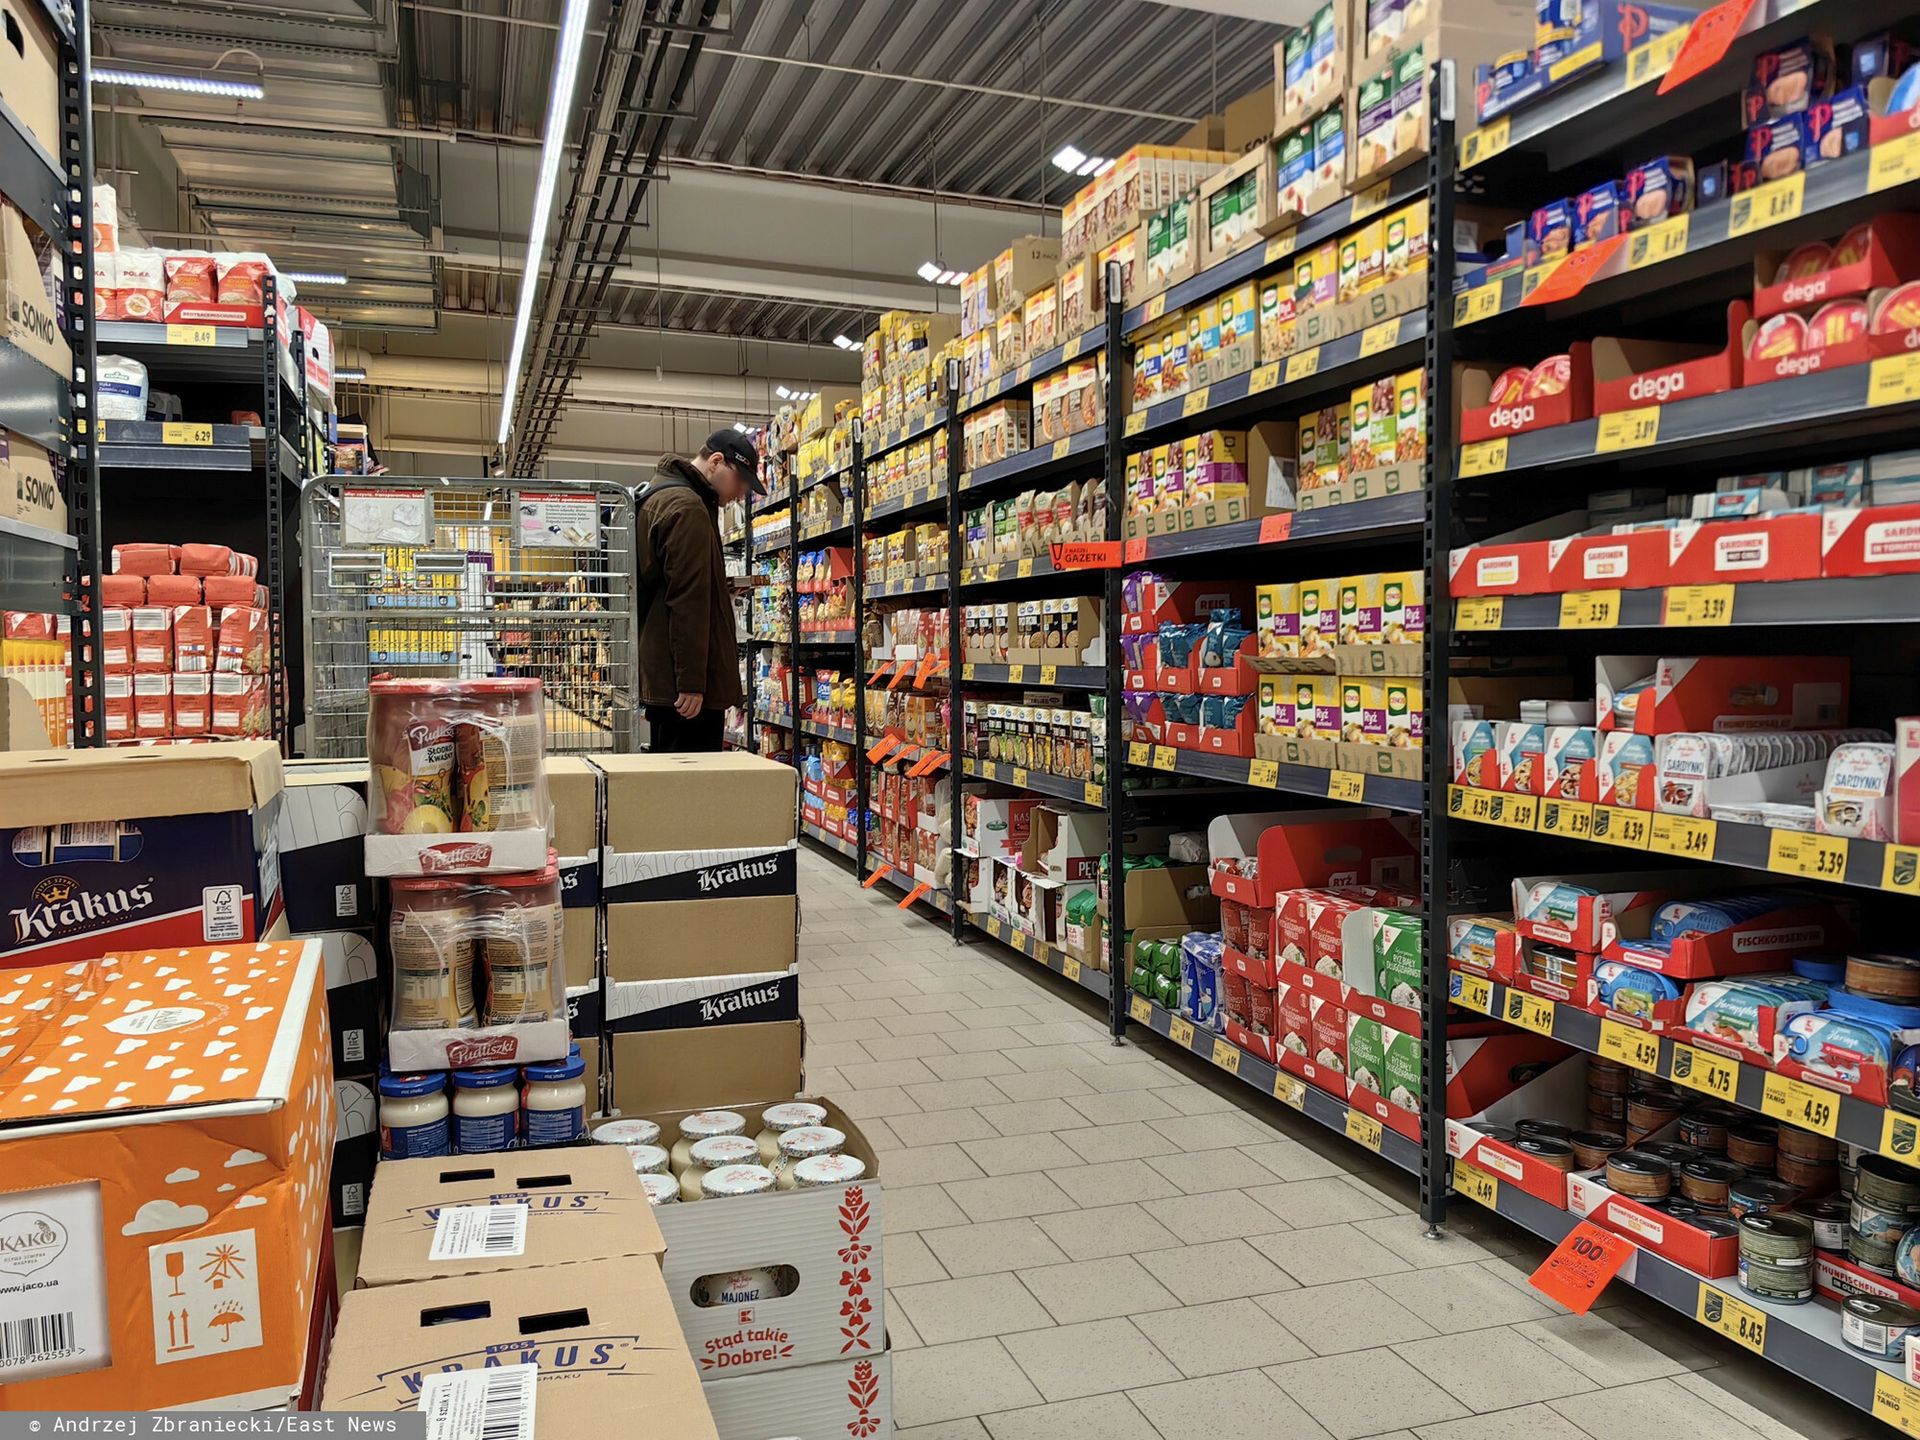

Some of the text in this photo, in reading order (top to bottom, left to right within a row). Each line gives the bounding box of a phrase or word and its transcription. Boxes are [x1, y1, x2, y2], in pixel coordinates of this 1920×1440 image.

[1782, 279, 1827, 303] dega
[21, 300, 55, 346] SONKO
[194, 332, 211, 343] 8.49
[1775, 355, 1821, 376] dega
[1628, 371, 1685, 402] dega
[1488, 403, 1535, 430] dega
[195, 431, 211, 442] 6.29
[25, 475, 55, 511] SONKO
[1719, 539, 1764, 550] SARDINEN
[1064, 553, 1107, 563] GAZETKI
[1200, 600, 1226, 610] REIS
[1275, 616, 1288, 629] Ryż
[1320, 609, 1334, 624] Ryż
[1359, 610, 1372, 625] Ryż
[1405, 607, 1420, 623] Ryż
[1275, 705, 1287, 719] Ryż
[1316, 708, 1329, 722] Ryż
[1363, 710, 1378, 725] Ryż
[1411, 713, 1423, 729] Ry
[1666, 758, 1704, 774] SARDYNKI
[1833, 773, 1882, 790] SARDYNKI
[1014, 812, 1030, 823] KAS
[1571, 813, 1590, 834] 8.39
[1623, 820, 1644, 842] 8.39
[1685, 830, 1708, 853] 3.49
[1078, 860, 1098, 880] PĘC
[1816, 850, 1844, 874] 3.39
[697, 855, 779, 892] Krakus
[1333, 877, 1353, 886] RYŻ
[8, 882, 154, 945] Krakus
[699, 982, 781, 1022] Krakus
[1472, 986, 1488, 1008] 4.75
[1534, 1008, 1552, 1030] 4.99
[449, 1039, 515, 1064] Pudliszki
[1636, 1042, 1657, 1068] 4.59
[1707, 1066, 1731, 1093] 4.75
[1765, 1092, 1786, 1105] TANIO
[1803, 1099, 1830, 1127] 4.59
[1367, 1128, 1381, 1147] 3.69
[1476, 1181, 1493, 1202] 6.49
[721, 1289, 760, 1303] MAJONEZ
[704, 1327, 789, 1354] Stąd takie
[1739, 1316, 1764, 1346] 8.43
[30, 1349, 72, 1363] 262553
[491, 1341, 530, 1353] 1965
[717, 1344, 777, 1368] Dobre!
[437, 1398, 450, 1416] sztuk
[1876, 1394, 1901, 1412] TANIO
